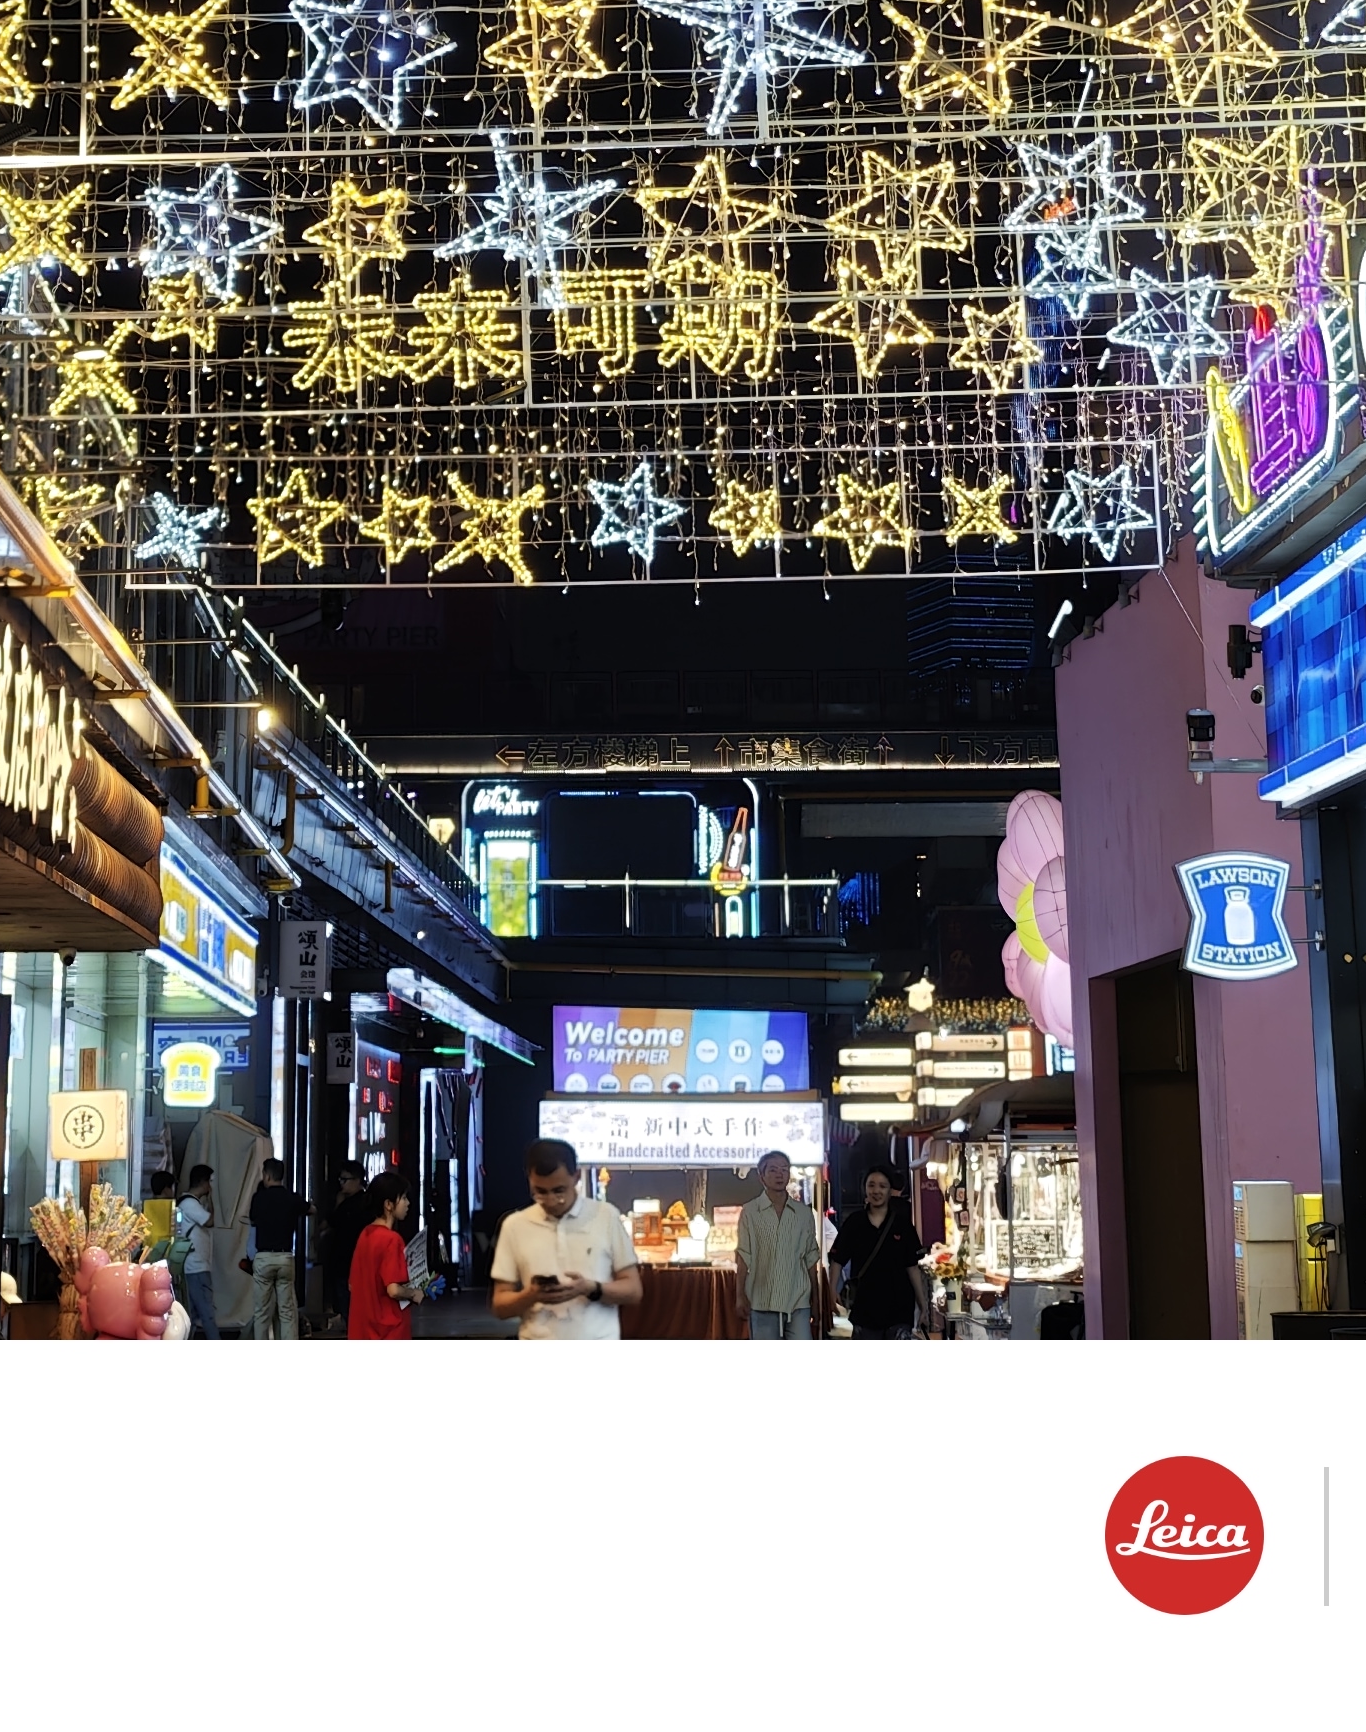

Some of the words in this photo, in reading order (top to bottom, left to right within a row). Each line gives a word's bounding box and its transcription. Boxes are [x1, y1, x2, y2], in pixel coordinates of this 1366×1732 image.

[283, 255, 778, 392] 未来可期
[305, 625, 377, 647] PARTY
[387, 625, 440, 647] PIER
[527, 737, 691, 768] 左方楼梯上
[738, 737, 870, 768] 市集食街
[495, 800, 539, 816] PARTY
[1195, 867, 1277, 888] LAWSON
[1202, 943, 1283, 963] STATION
[564, 1021, 684, 1046] Welcome
[565, 1048, 582, 1062] To
[587, 1048, 633, 1063] PARTY
[635, 1049, 670, 1065] PIER
[73, 1110, 95, 1142] 串
[644, 1116, 763, 1137] 新中式手作
[608, 1142, 690, 1159] Handcrafted
[693, 1142, 770, 1159] Accessories
